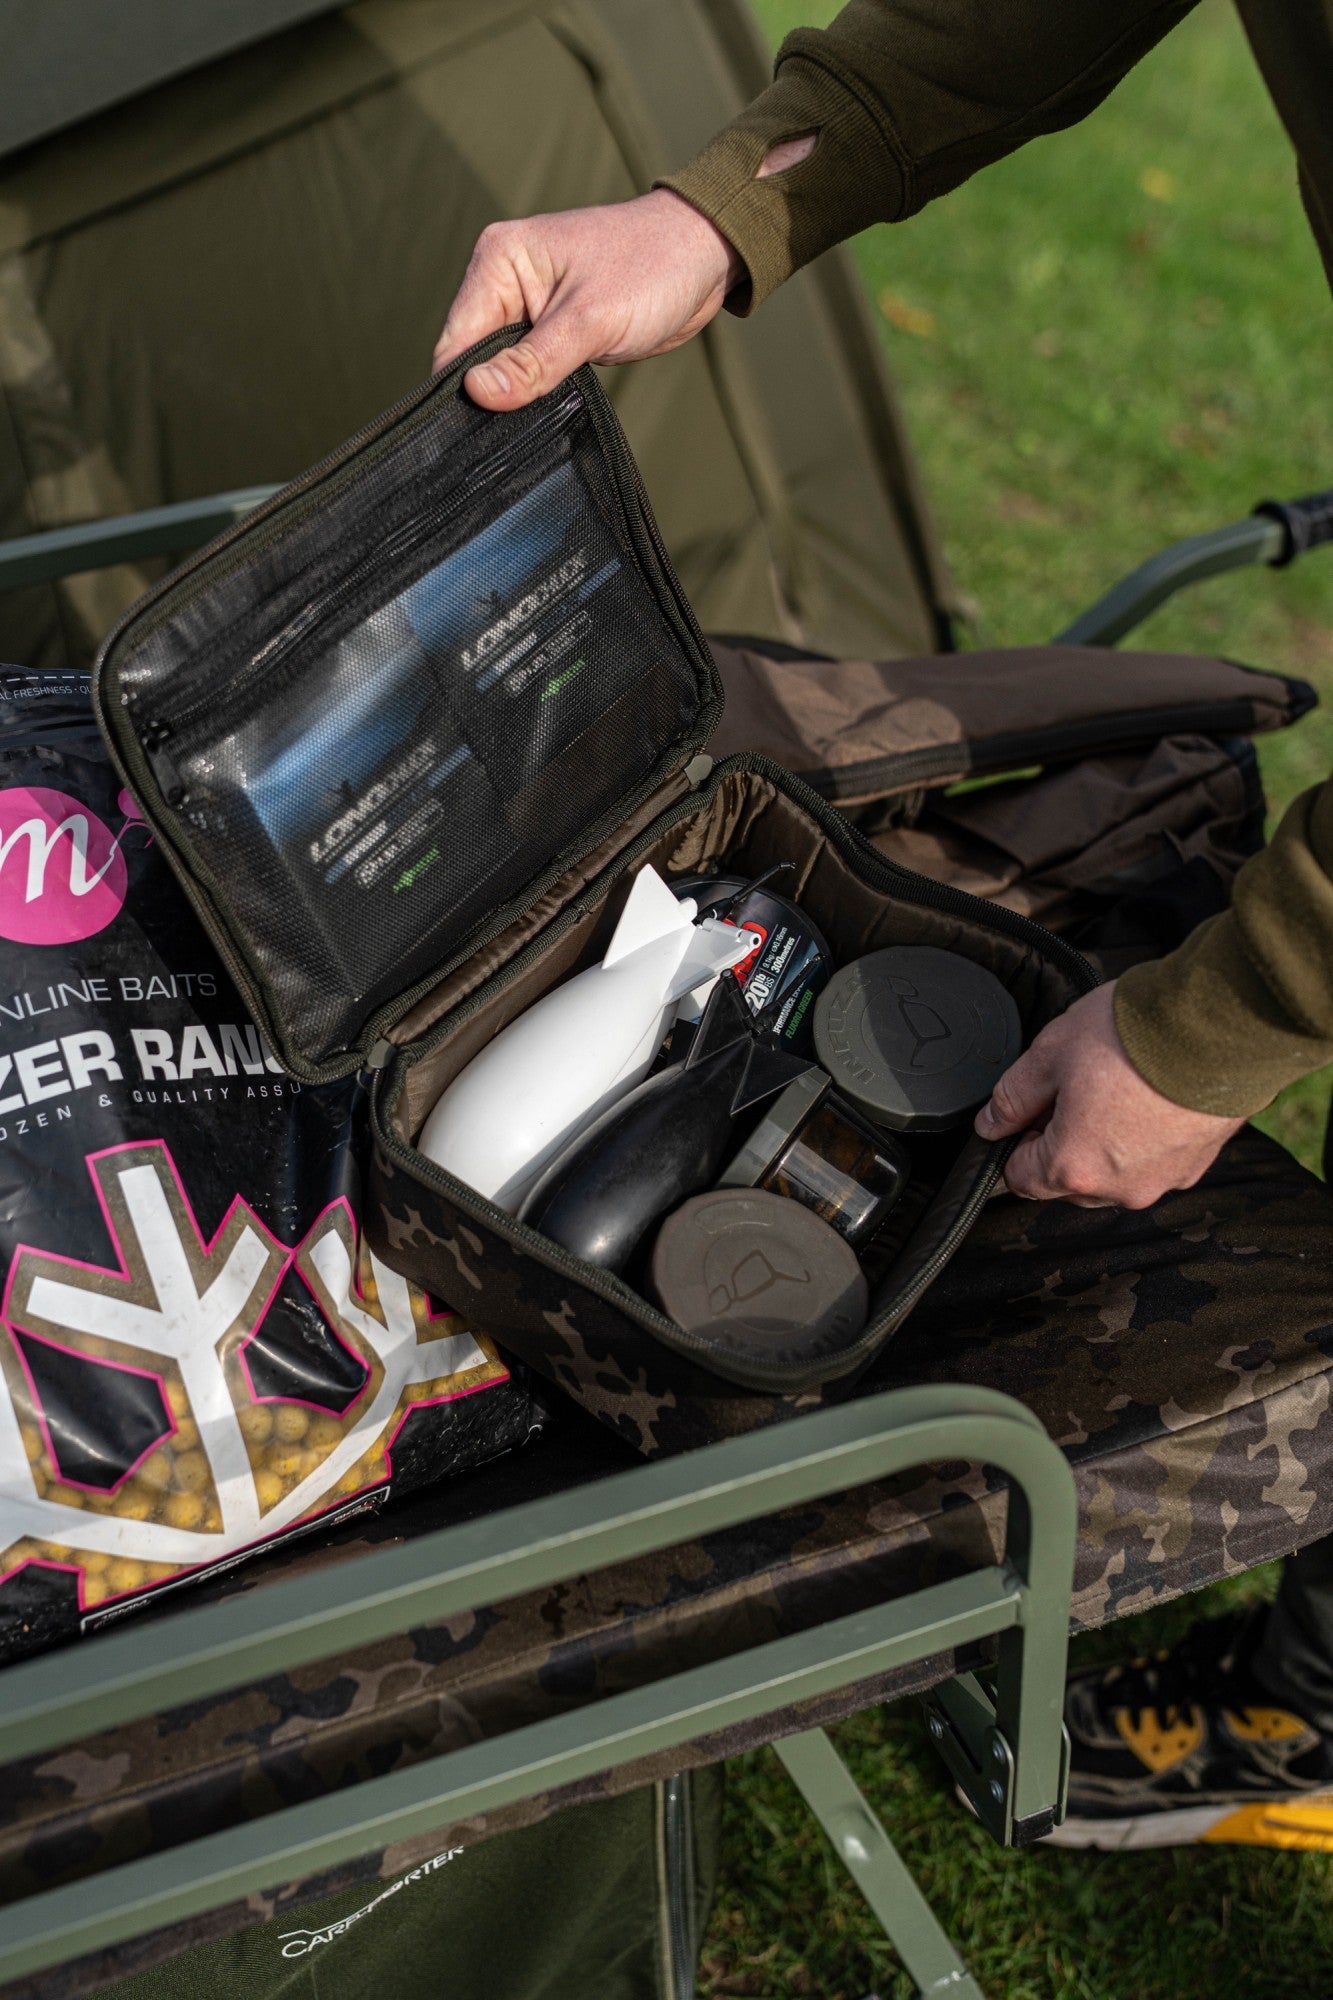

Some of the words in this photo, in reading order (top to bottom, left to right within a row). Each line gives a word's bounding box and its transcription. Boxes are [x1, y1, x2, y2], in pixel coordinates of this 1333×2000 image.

[13, 685, 73, 699] FRESHNESS
[119, 973, 217, 1001] BAITS
[785, 1011, 803, 1039] FLUORO
[798, 989, 814, 1014] GREEN
[98, 1094, 112, 1107] &
[132, 1087, 229, 1104] QUALITY
